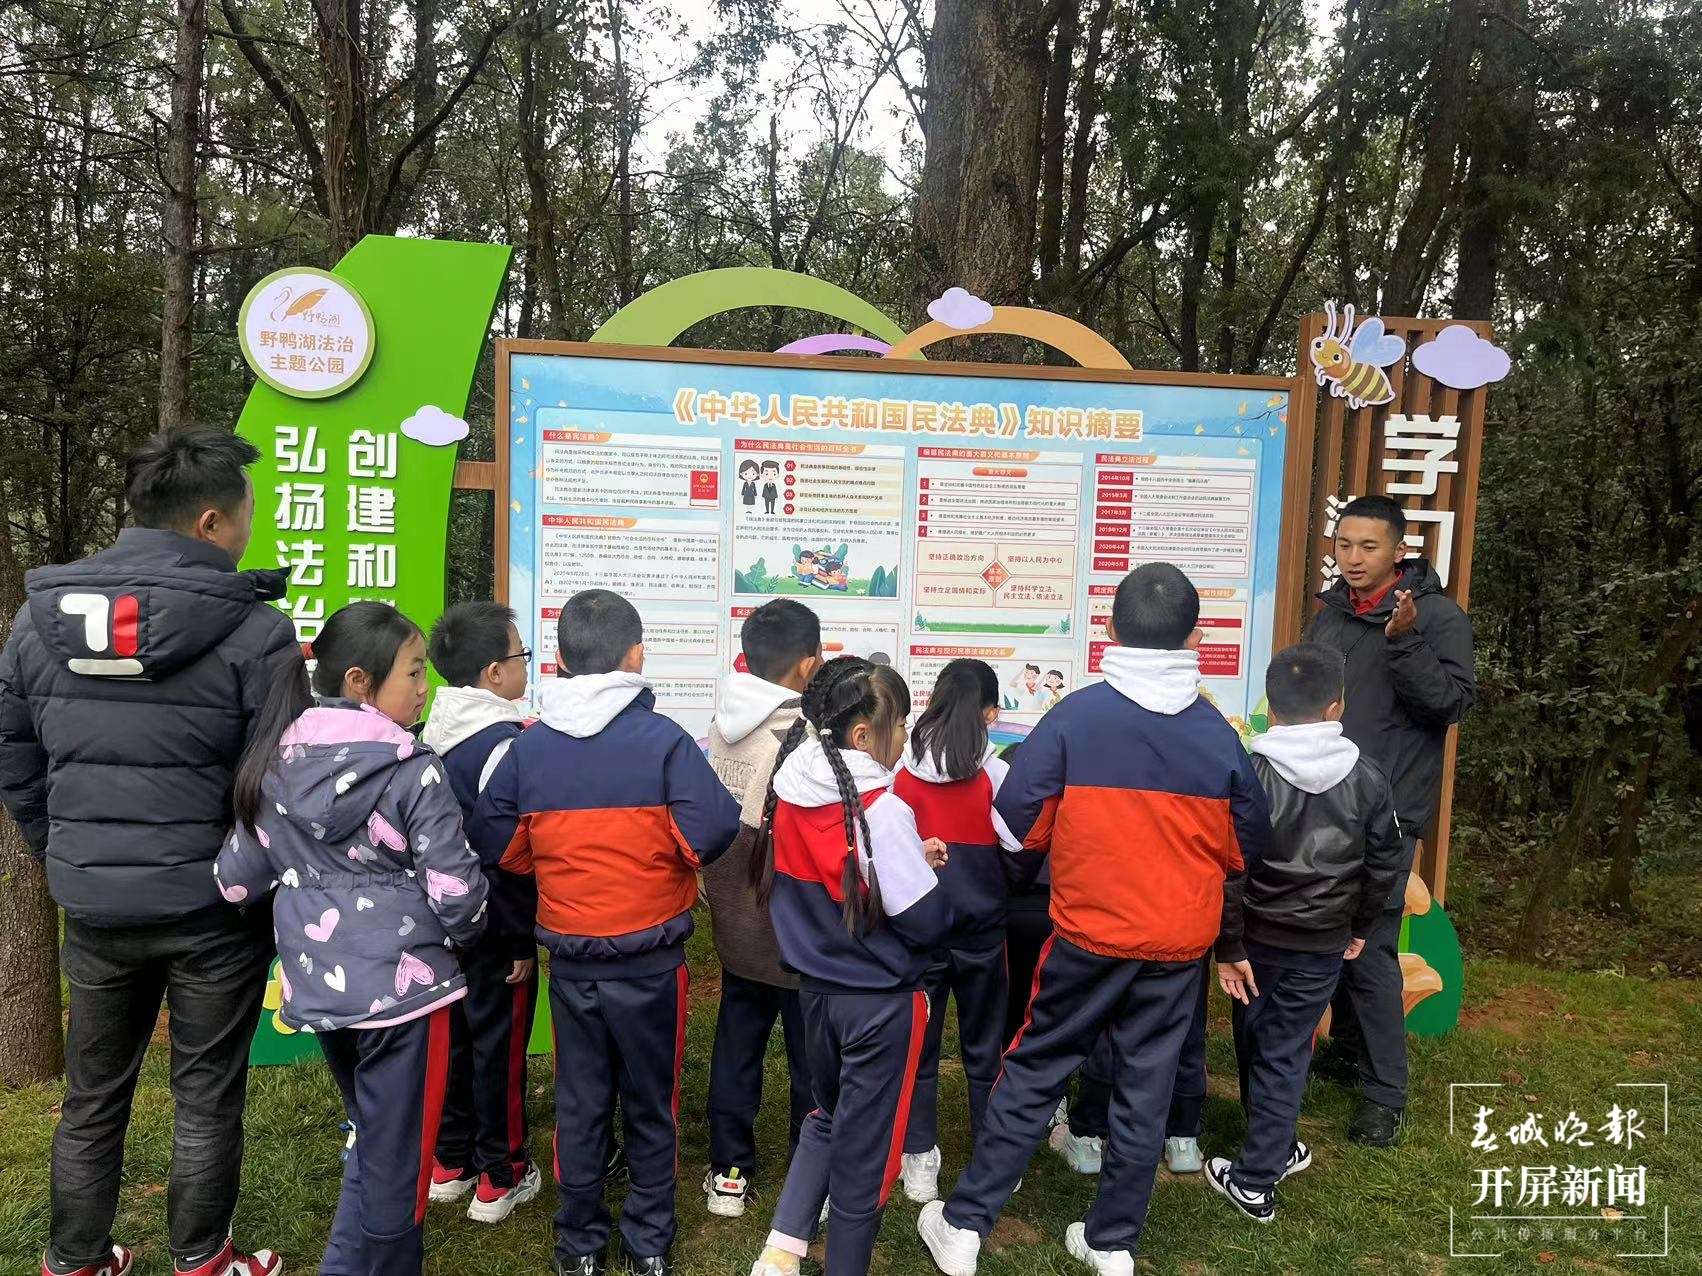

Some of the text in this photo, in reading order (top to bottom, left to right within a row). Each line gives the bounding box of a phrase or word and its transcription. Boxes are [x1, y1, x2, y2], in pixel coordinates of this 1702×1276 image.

[259, 329, 354, 354] 野鸭湖法治
[270, 354, 345, 375] 主题公园
[675, 390, 1142, 440] 《中华人民共和国民法典》知识摘要
[1100, 455, 1149, 464] 民法典立法过程
[347, 430, 398, 612] 创建和
[548, 516, 625, 527] 中华人民共和国民法典
[274, 425, 326, 643] 弘扬法治
[928, 553, 985, 563] 坚持正确政治方向
[1007, 555, 1063, 565] 坚持以人民为中心
[923, 586, 987, 595] 坚持立足国情和实际
